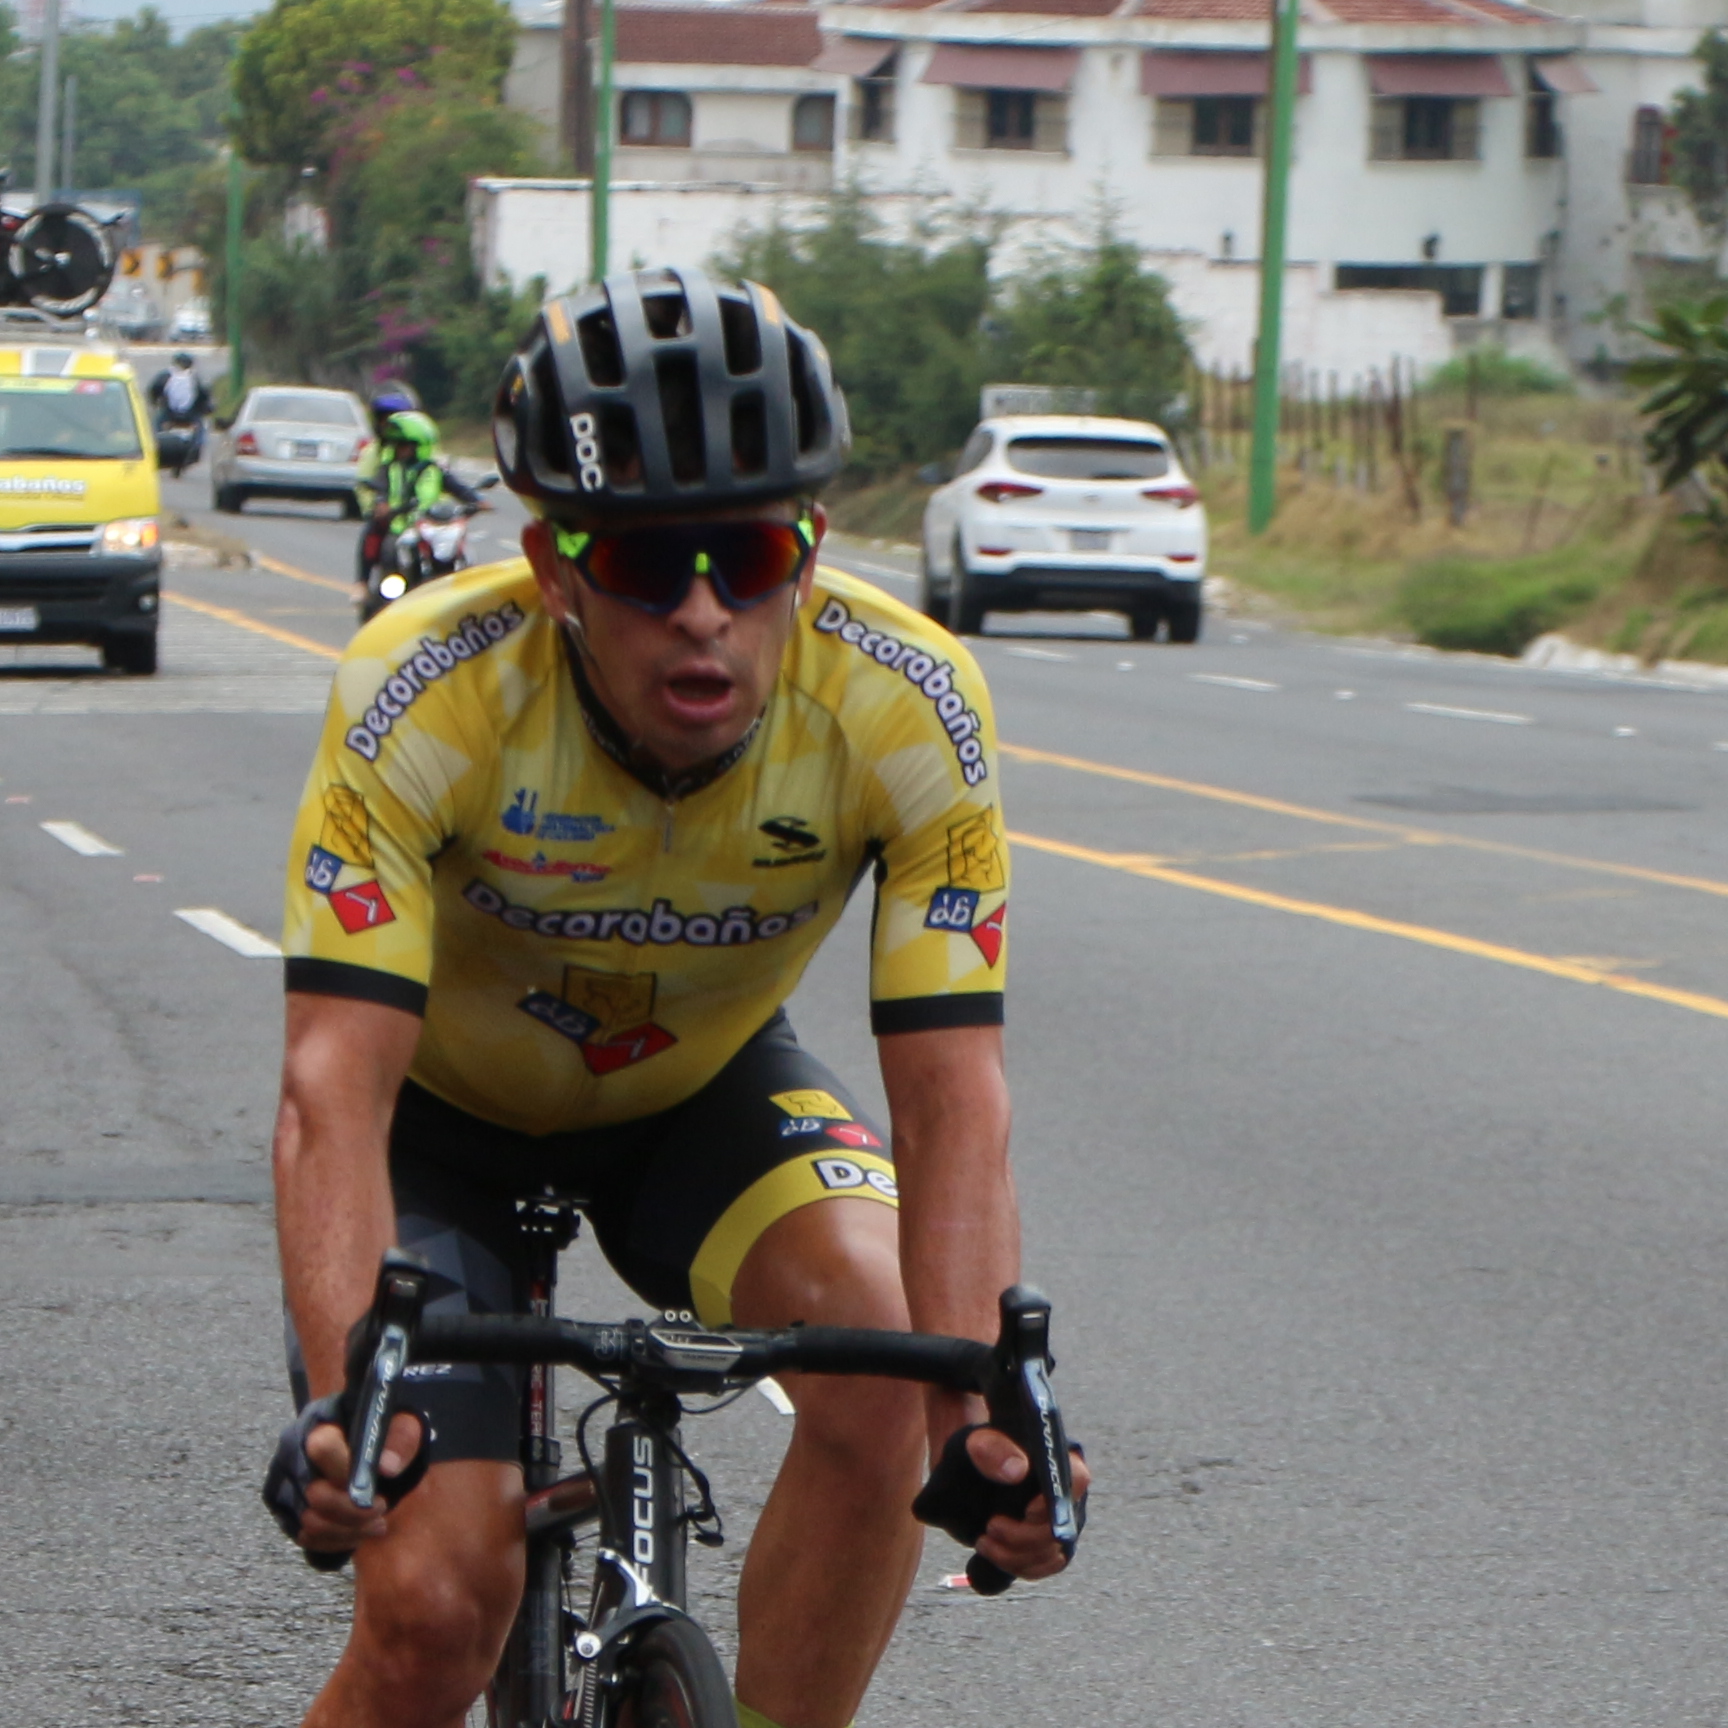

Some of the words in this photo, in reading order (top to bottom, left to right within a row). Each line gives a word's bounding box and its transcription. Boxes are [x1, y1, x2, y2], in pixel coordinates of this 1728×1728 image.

[346, 600, 527, 762] Decorabaños
[814, 597, 988, 787] Decorabaños
[463, 877, 821, 947] Decorabaños
[810, 1157, 899, 1198] De
